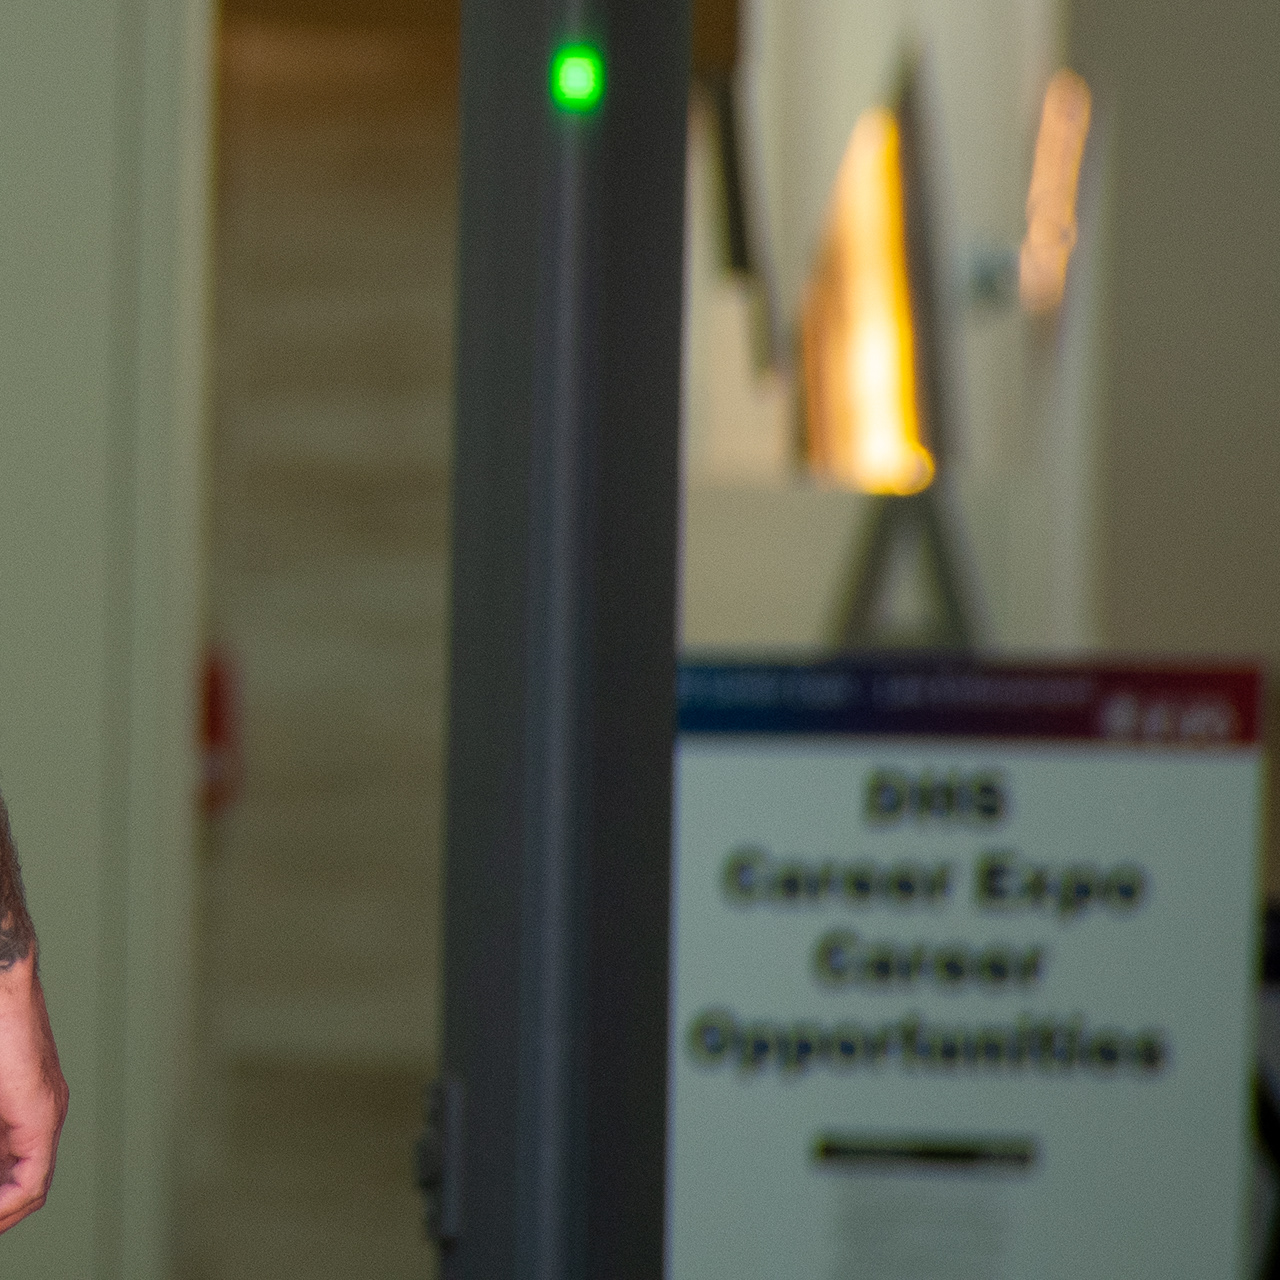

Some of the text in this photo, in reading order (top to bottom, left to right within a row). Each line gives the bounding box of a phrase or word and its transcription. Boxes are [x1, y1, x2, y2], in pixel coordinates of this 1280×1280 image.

[723, 850, 1147, 918] Career Expo
[814, 932, 1044, 990] Career
[690, 1013, 1167, 1082] Opportunities
